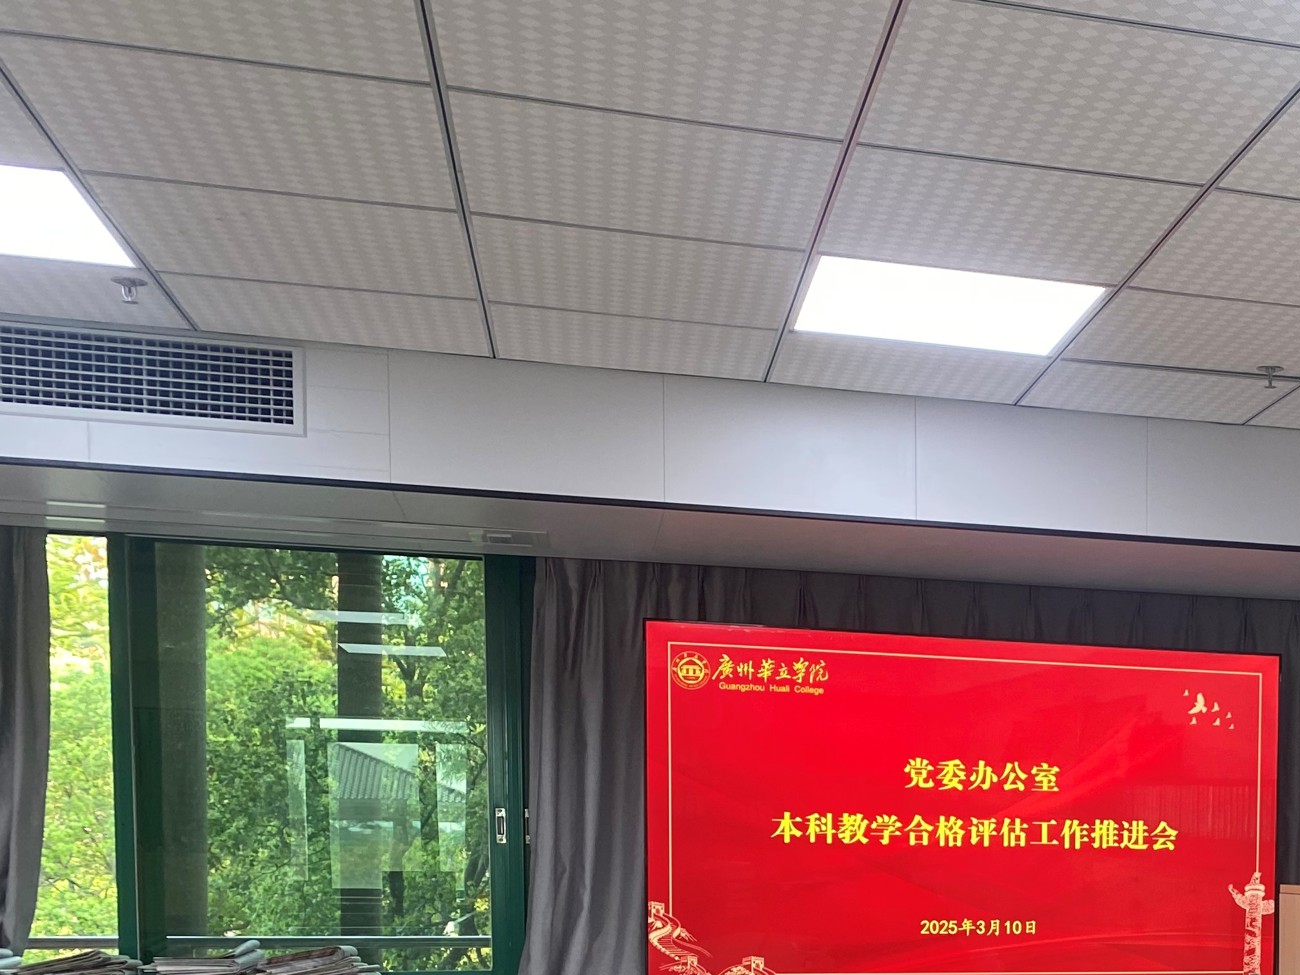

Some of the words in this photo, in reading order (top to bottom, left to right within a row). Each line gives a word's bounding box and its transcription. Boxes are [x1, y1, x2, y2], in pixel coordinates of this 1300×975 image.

[718, 681, 765, 692] Guangzhou
[769, 684, 790, 693] Huali
[793, 685, 824, 695] College
[904, 757, 1061, 792] 党委办公室
[770, 811, 1179, 851] 本科教学合格评估工作推进会
[920, 918, 1036, 936] 2025年3月10日
